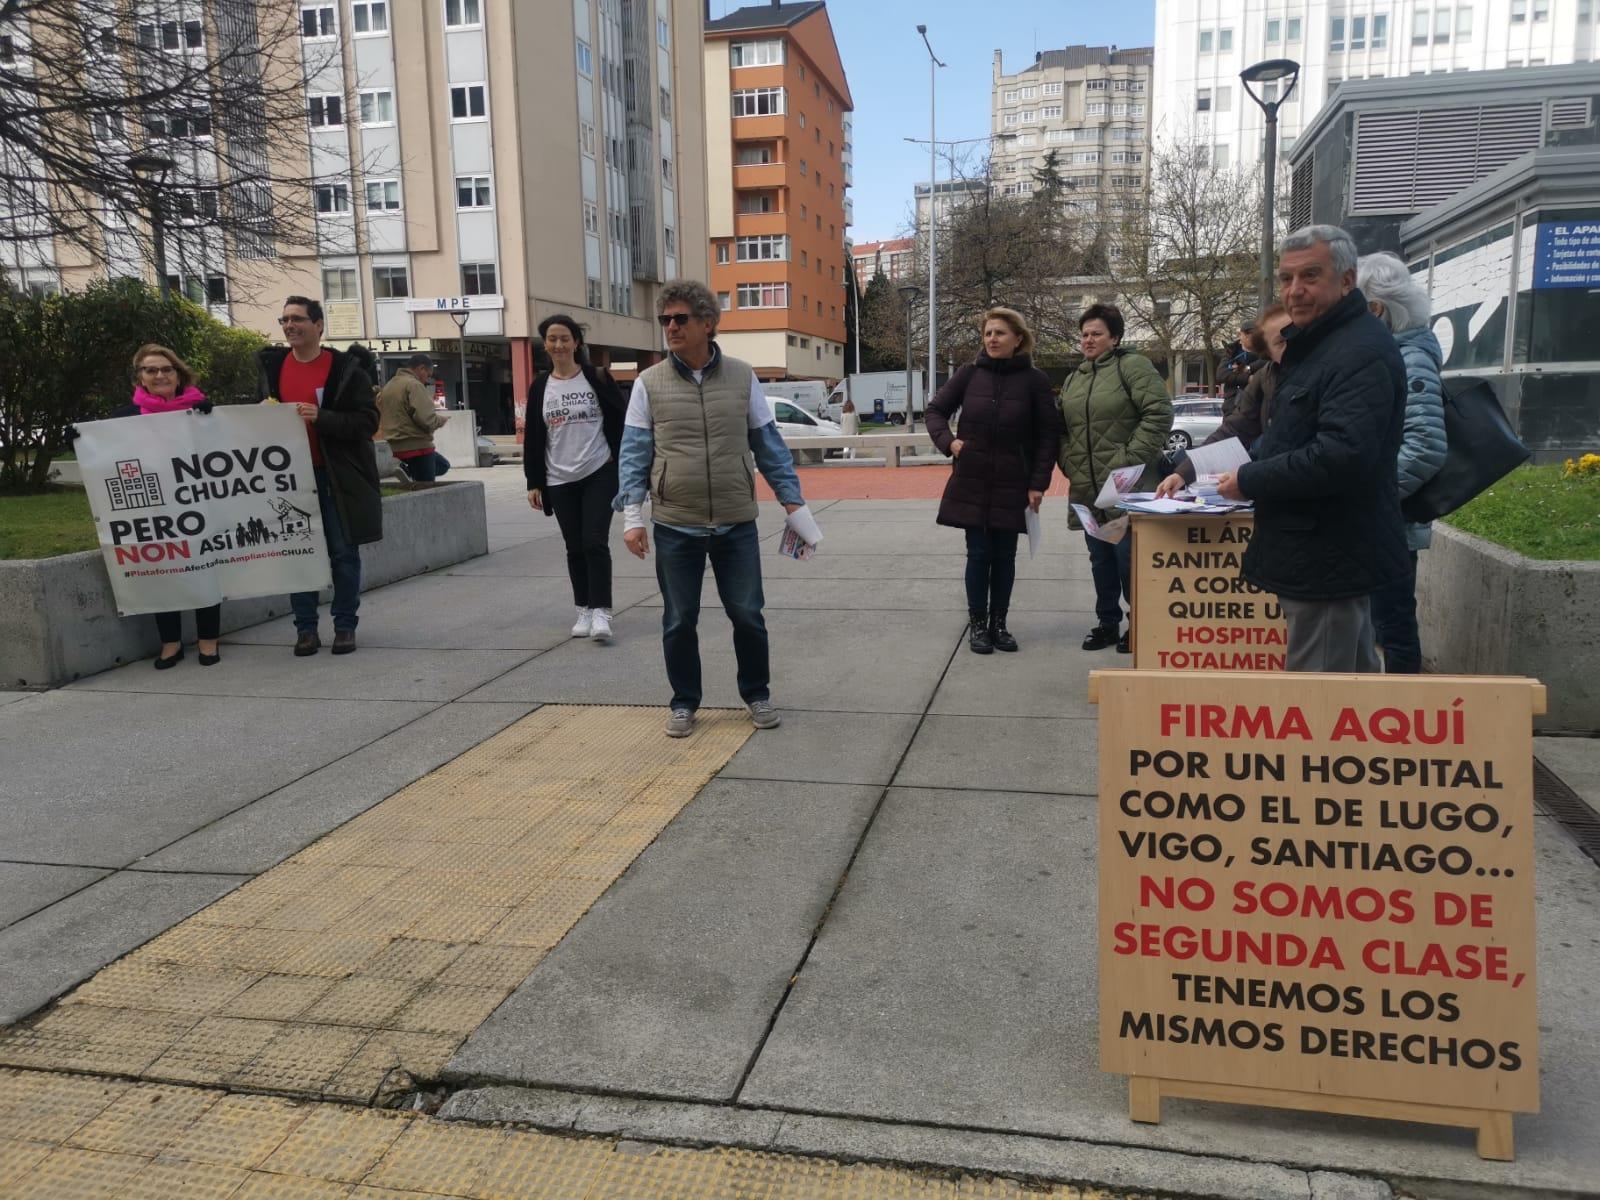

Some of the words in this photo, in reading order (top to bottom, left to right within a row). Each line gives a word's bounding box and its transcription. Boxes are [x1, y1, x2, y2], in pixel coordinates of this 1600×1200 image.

[1555, 226, 1569, 235] EL
[437, 297, 471, 309] MPE
[545, 407, 570, 418] PERO
[561, 391, 594, 401] NOVO
[561, 399, 588, 407] CHUAC
[171, 445, 291, 483] NOVO
[174, 475, 266, 505] CHUAC
[275, 473, 297, 492] SI
[109, 510, 206, 545] PERO
[1187, 527, 1211, 543] EL
[1218, 521, 1251, 544] ÁR
[114, 540, 191, 565] NON
[199, 530, 232, 555] ASÍ
[1152, 551, 1244, 568] SANITA
[1168, 577, 1185, 593] A
[1168, 601, 1255, 620] QUIERE
[1264, 602, 1287, 620] U
[1158, 651, 1286, 671] TOTALMEN
[1160, 703, 1313, 741] FIRMA
[1329, 697, 1465, 745] AQUÍ
[1130, 749, 1211, 779] POR
[1224, 752, 1285, 782] UN
[1301, 754, 1504, 790] HOSPITAL
[1119, 789, 1246, 823] COMO
[1260, 795, 1301, 825] EL
[1314, 797, 1363, 828] DE
[1379, 799, 1514, 839] LUGO,
[1117, 830, 1236, 868] VIGO,
[1250, 833, 1515, 878] SANTIAGO...
[1140, 875, 1216, 912] NO
[1232, 880, 1415, 925] SOMOS
[1434, 891, 1493, 929] DE
[1113, 921, 1346, 971] SEGUNDA
[1361, 938, 1526, 992] CLASE,
[1171, 972, 1365, 1018] TENEMOS
[1381, 988, 1461, 1023] LOS
[1119, 1010, 1285, 1052] MISMOS
[1300, 1025, 1522, 1072] DERECHOS
